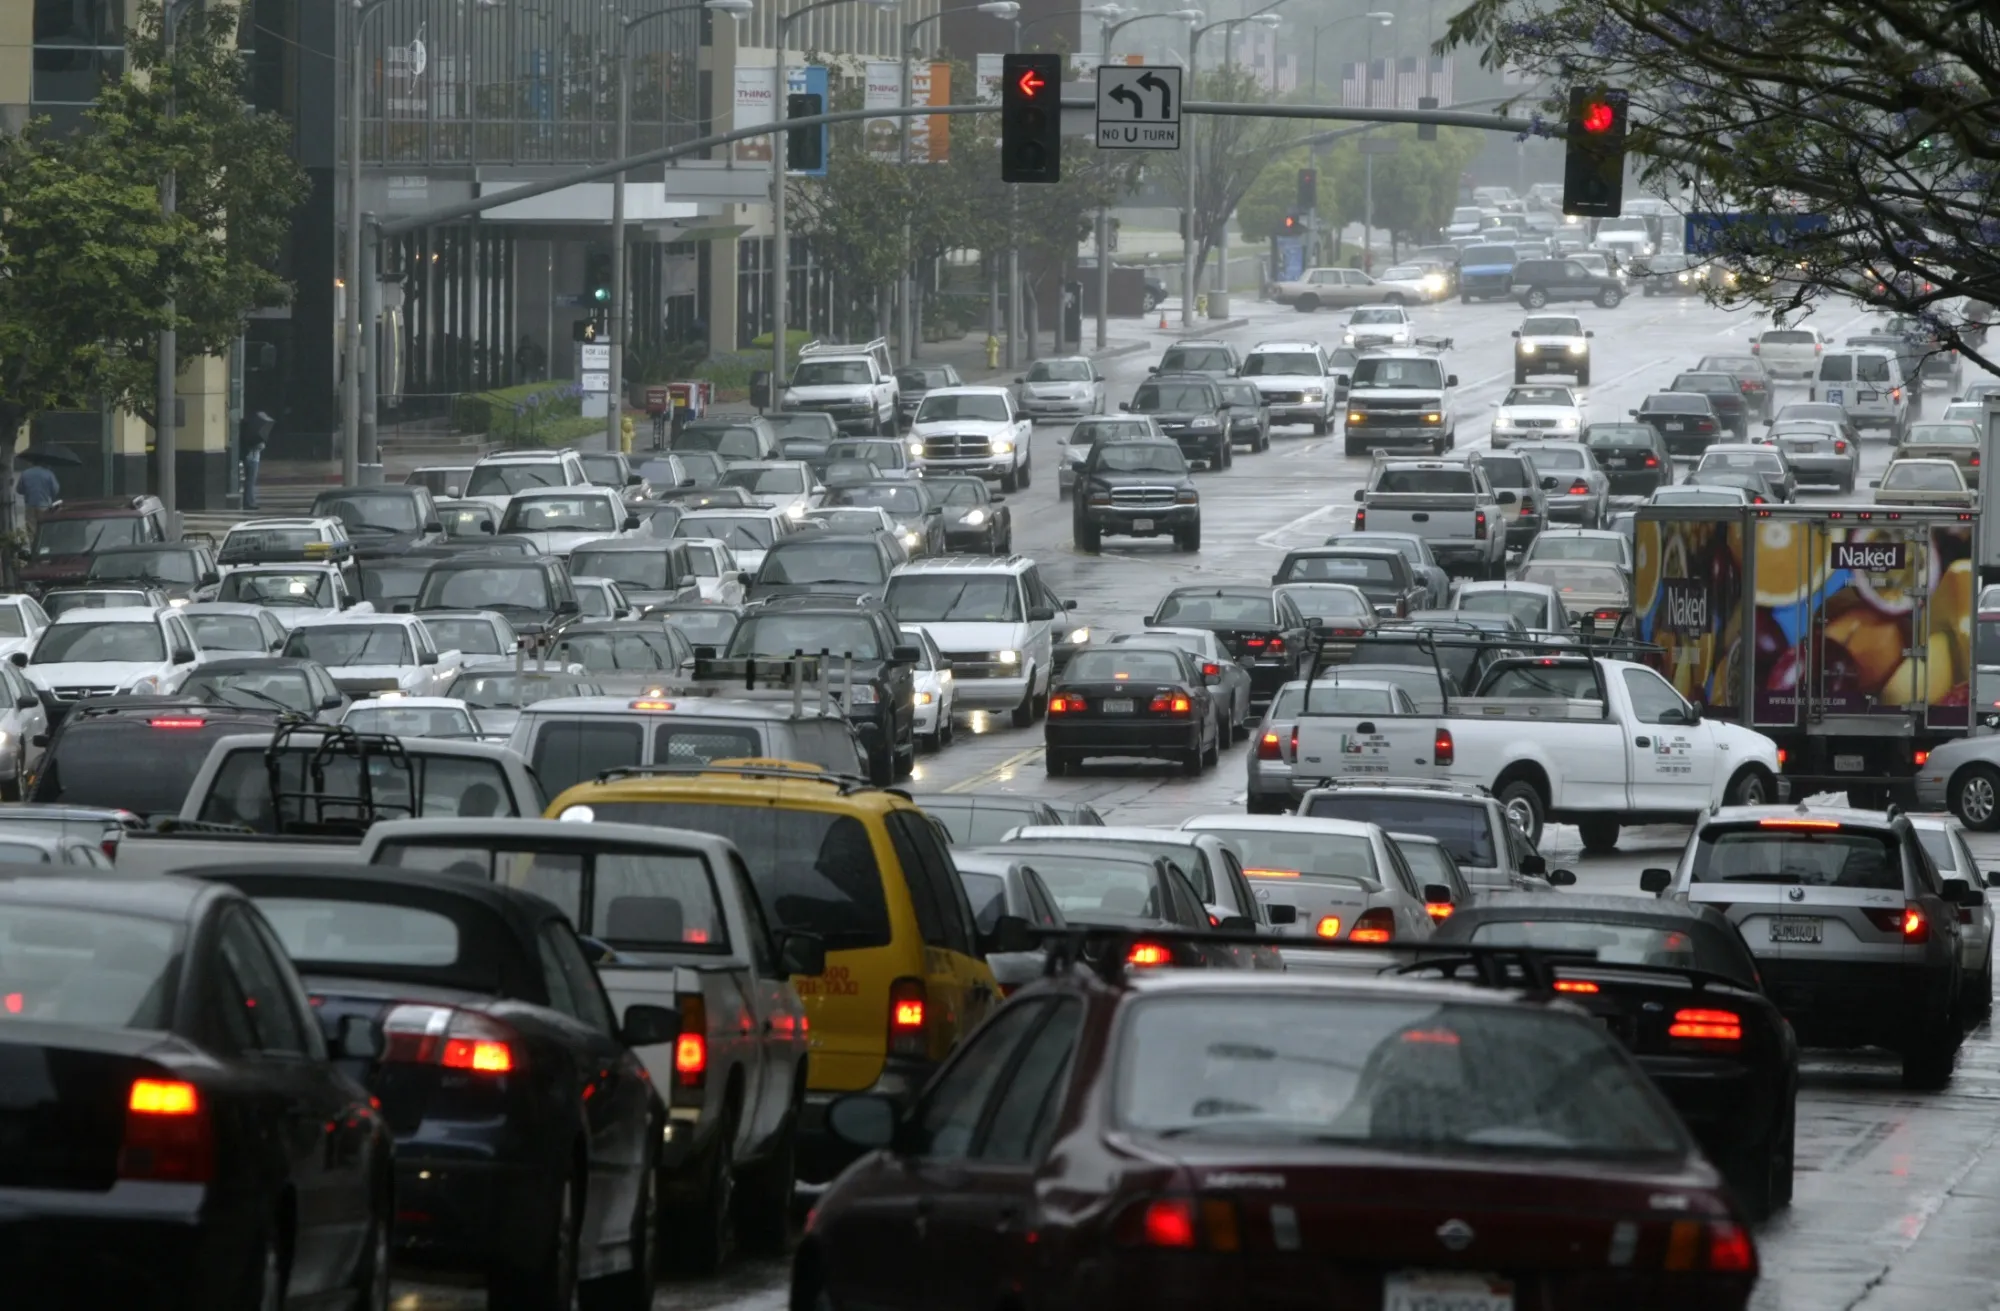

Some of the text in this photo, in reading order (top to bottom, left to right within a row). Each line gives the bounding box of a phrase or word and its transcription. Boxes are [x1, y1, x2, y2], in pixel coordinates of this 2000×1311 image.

[737, 90, 771, 98] THING
[868, 84, 899, 93] THING
[1102, 127, 1175, 143] NO U TURN
[585, 348, 596, 356] FOR
[1839, 546, 1897, 567] Naked
[1668, 586, 1707, 627] Naked
